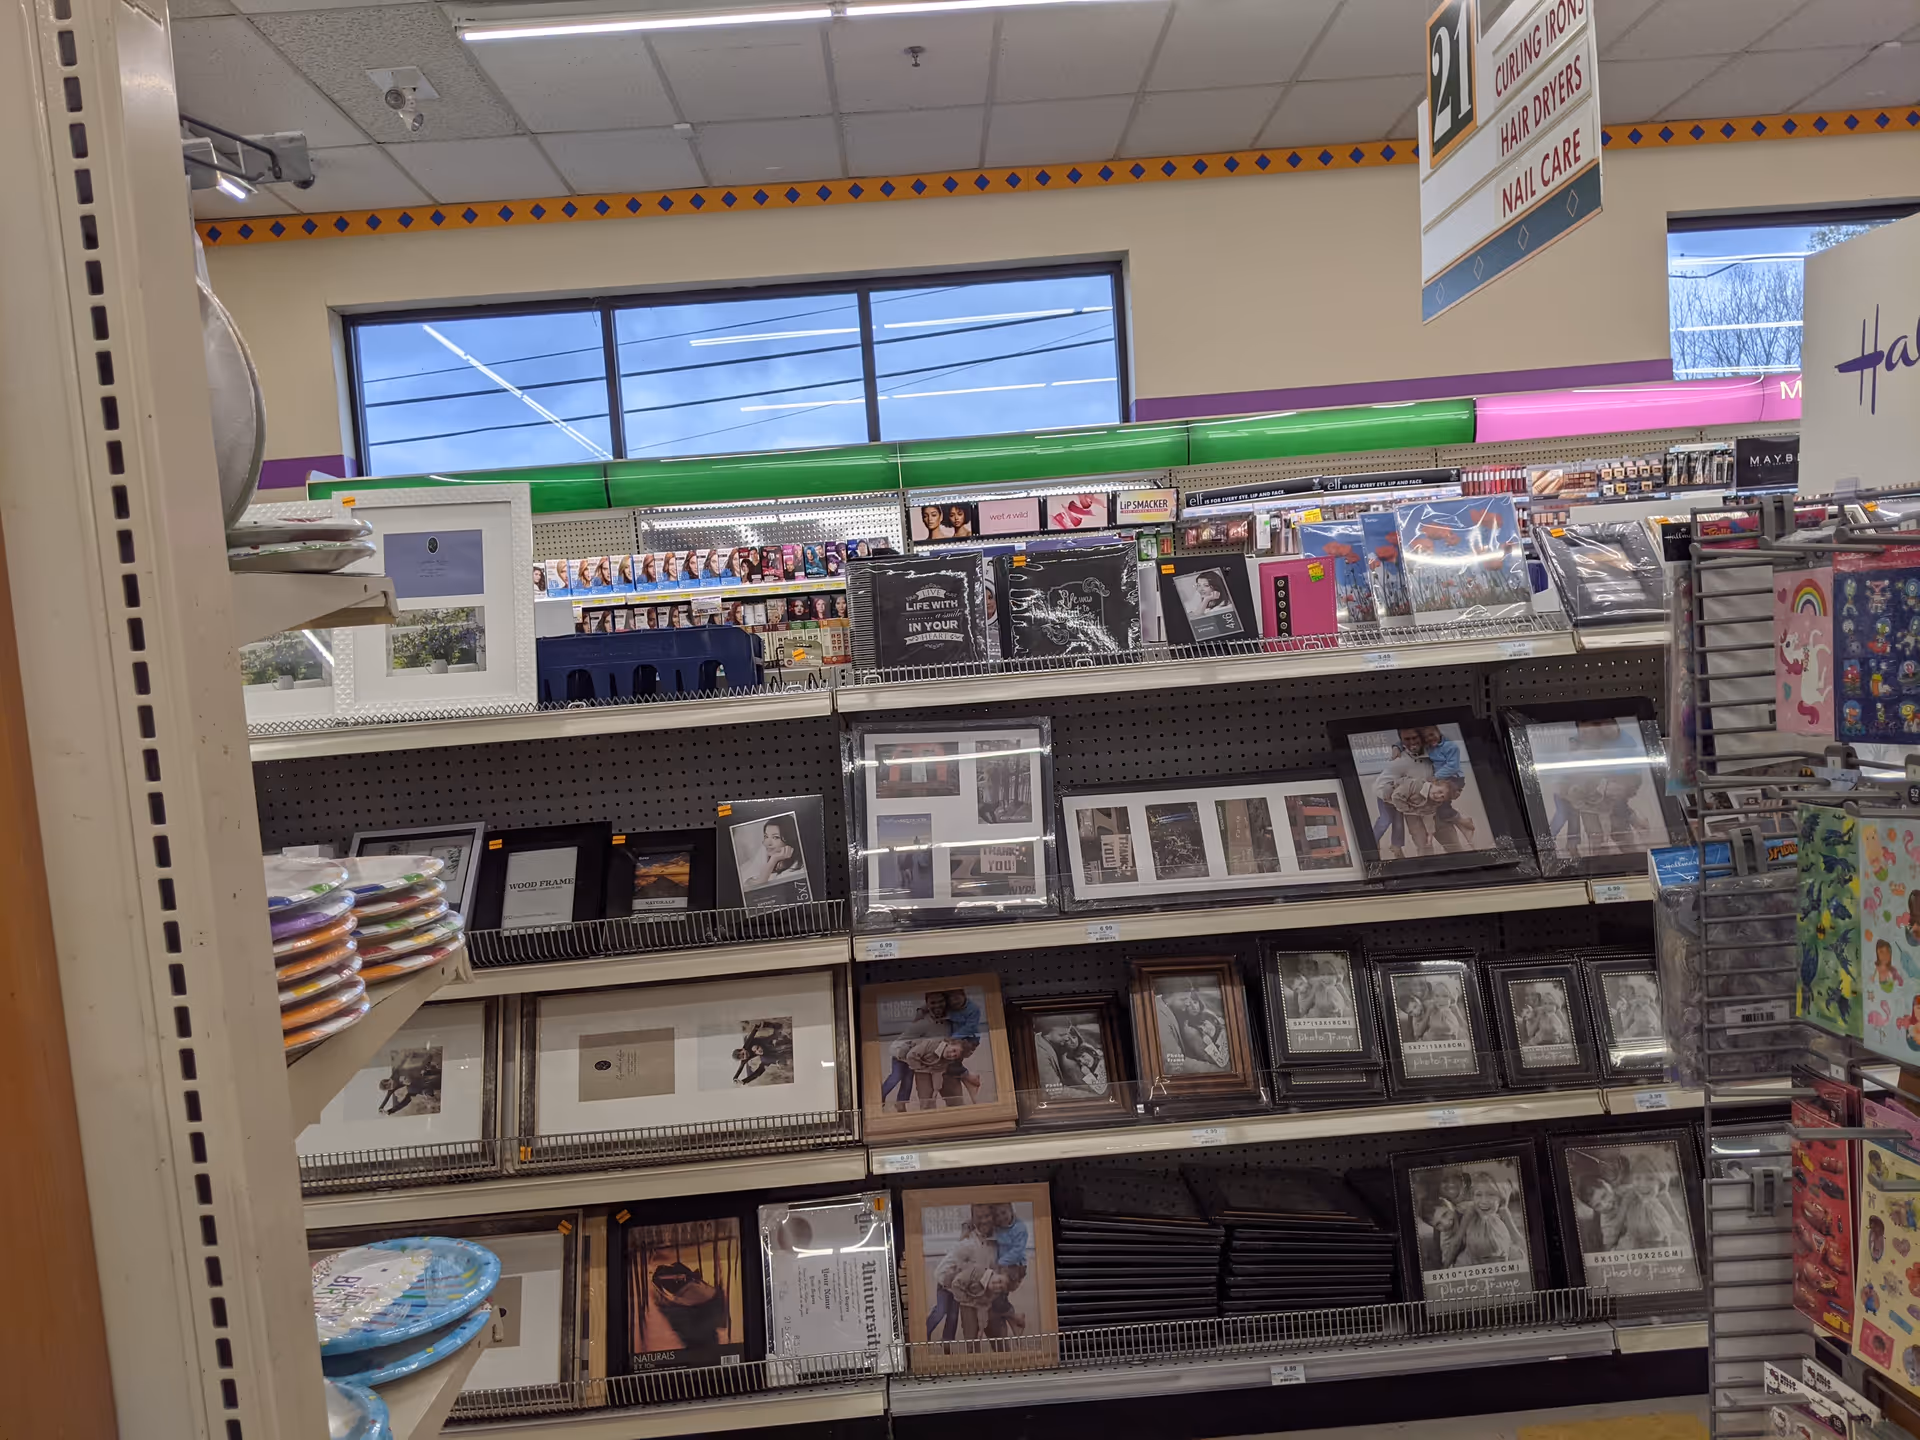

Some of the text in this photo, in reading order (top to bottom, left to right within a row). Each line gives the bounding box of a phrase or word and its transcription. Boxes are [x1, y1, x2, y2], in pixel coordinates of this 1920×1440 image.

[1495, 25, 1542, 97] CURLING
[1432, 0, 1471, 143] 21
[1501, 54, 1582, 157] HAIR DRYERS
[1502, 128, 1581, 218] NAIL CARE
[1834, 303, 1920, 415] Ha
[1327, 477, 1343, 490] elf
[1133, 499, 1168, 509] SMACKER
[1189, 493, 1204, 506] elf
[1222, 495, 1238, 503] EVERY
[989, 512, 1005, 521] wet
[1012, 510, 1029, 519] wild
[906, 599, 958, 611] LIFE WITH
[1057, 590, 1079, 609] Life
[909, 620, 958, 632] IN YOUR
[921, 633, 948, 641] HEART
[1102, 841, 1116, 867] YOU!
[989, 859, 1015, 871] YOU!
[509, 881, 537, 890] WOOD
[539, 878, 574, 887] FRAME
[821, 1267, 830, 1286] Your
[862, 1259, 881, 1360] University
[633, 1351, 676, 1363] NATURALS
[1780, 1374, 1796, 1387] HELLO
[1816, 1372, 1831, 1385] HELLO
[1816, 1377, 1832, 1390] KITTY
[1780, 1379, 1798, 1392] KITTY
